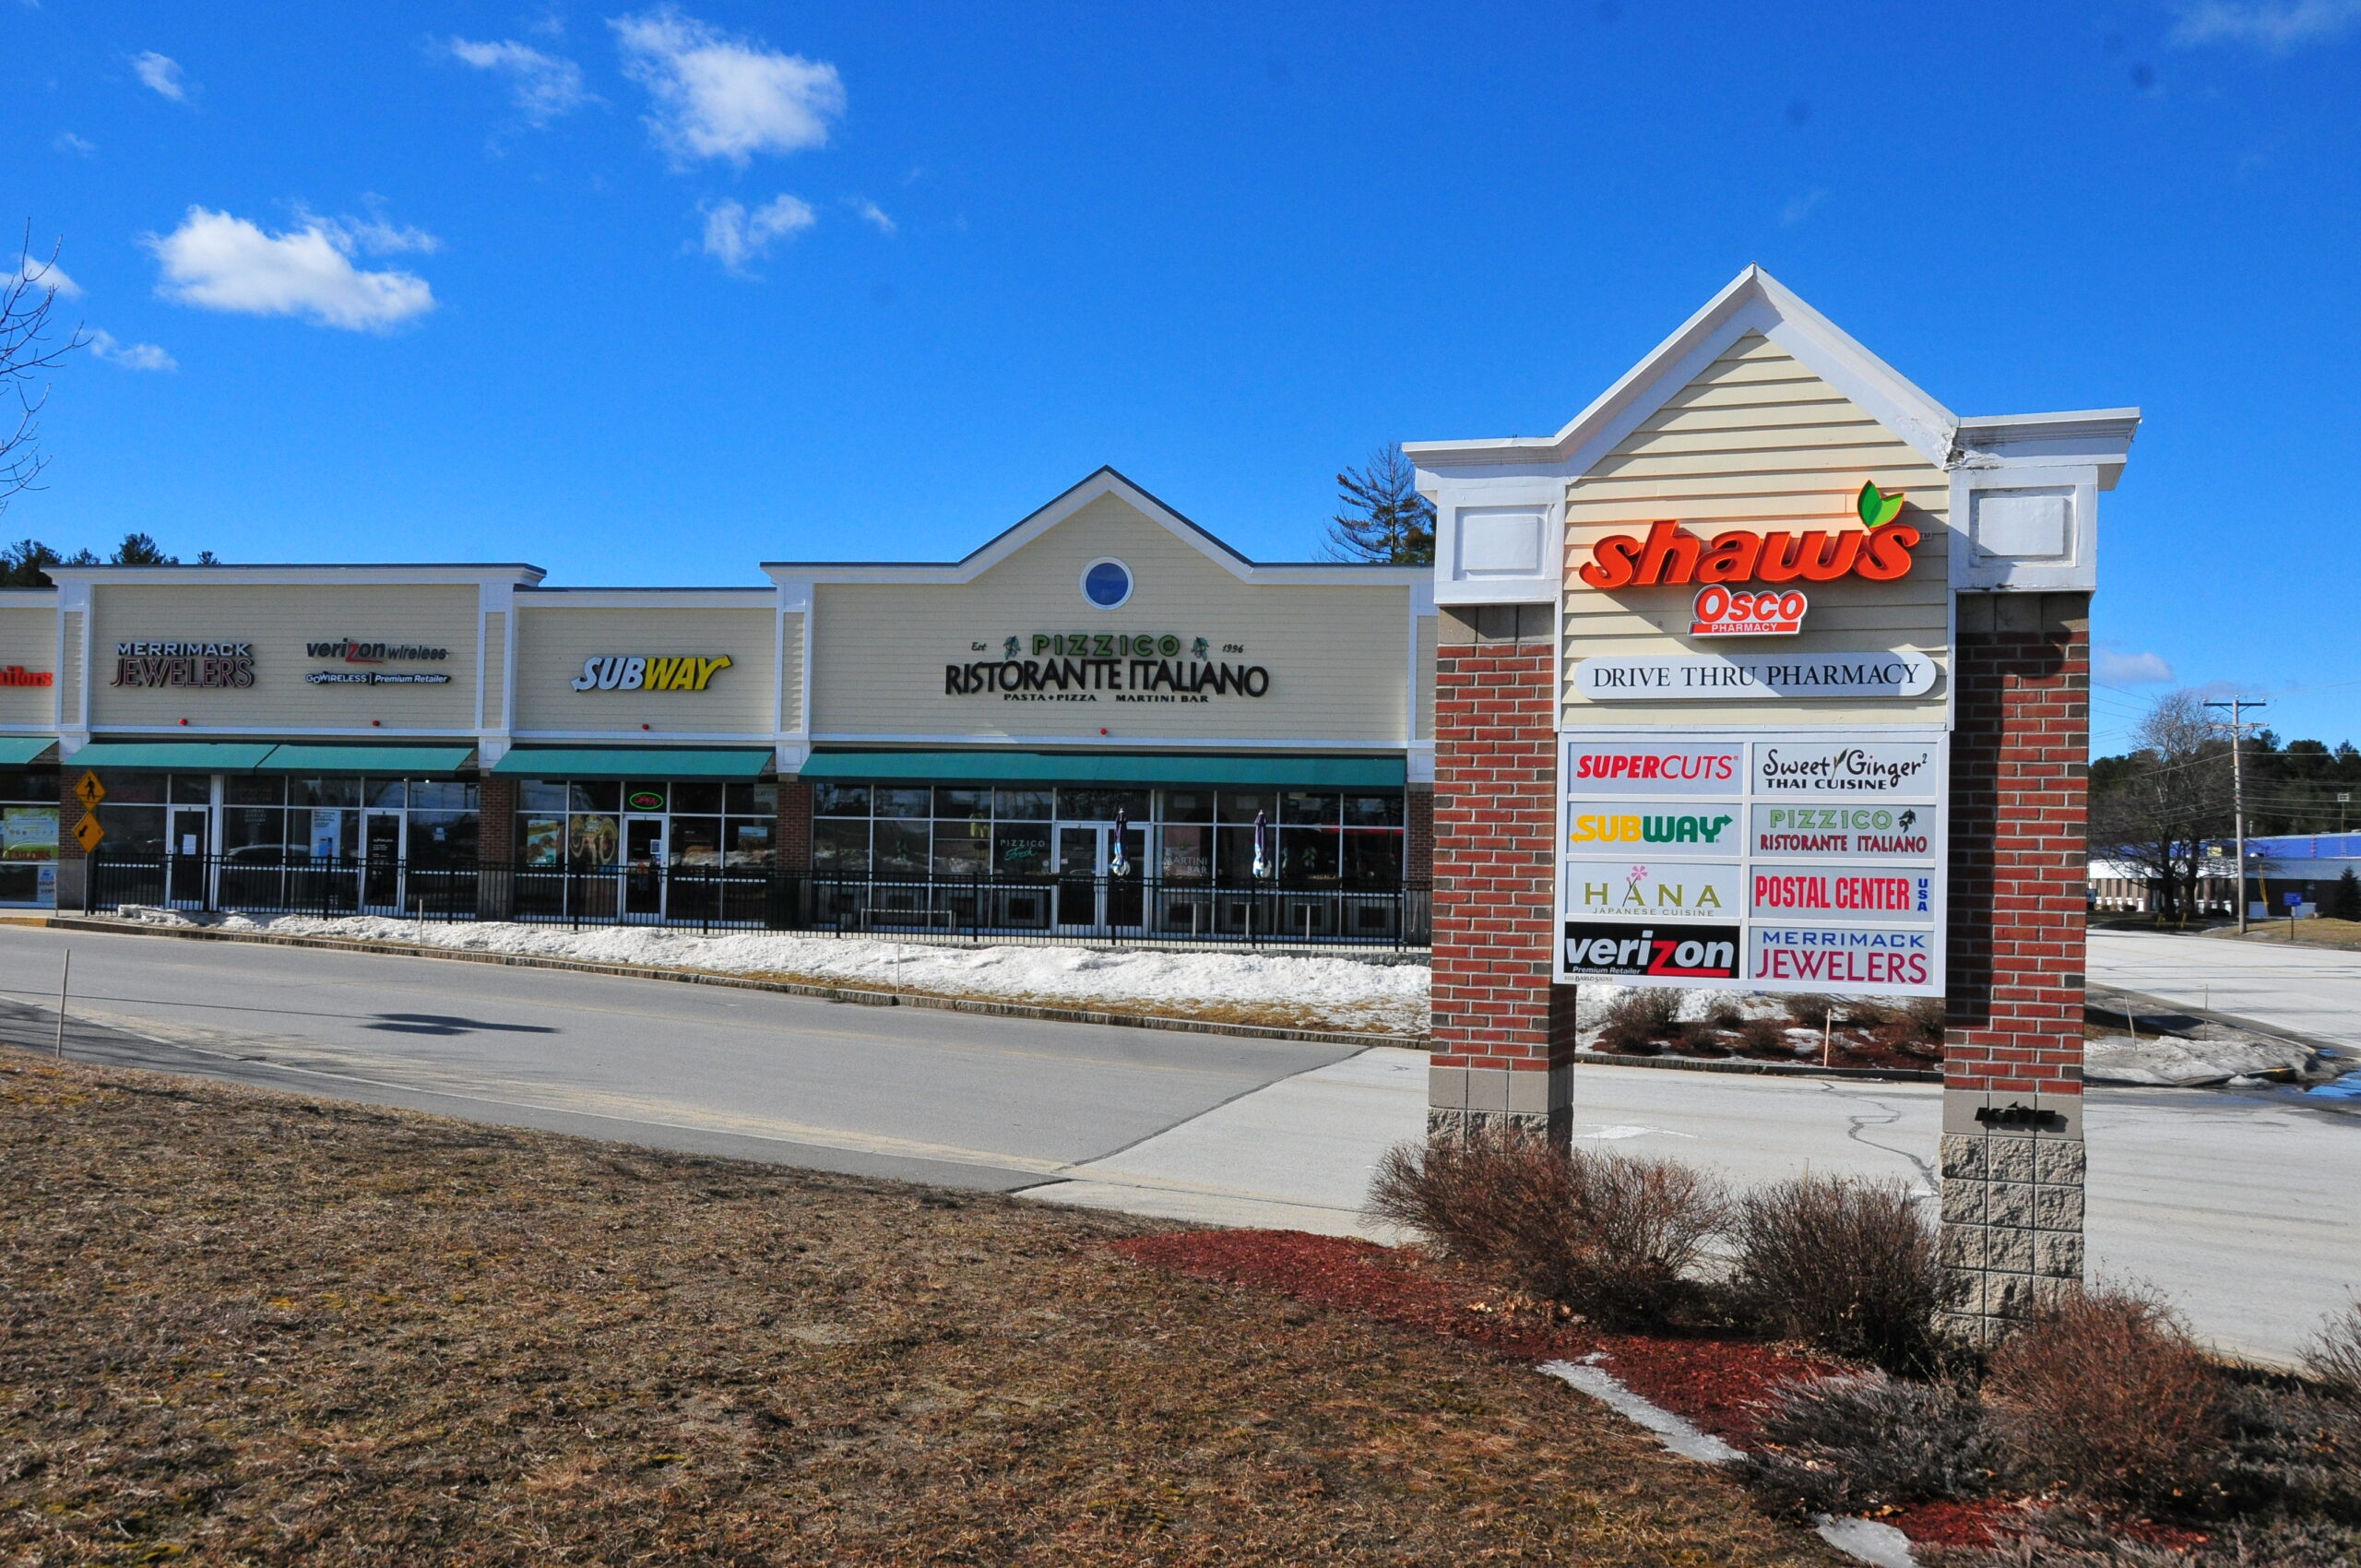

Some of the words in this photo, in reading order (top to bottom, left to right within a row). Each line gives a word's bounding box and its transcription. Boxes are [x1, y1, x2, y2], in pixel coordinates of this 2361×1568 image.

[1711, 623, 1778, 633] PHARMACY
[117, 642, 253, 658] MERRIMACK
[306, 637, 386, 663] verizon
[387, 645, 449, 660] wireless
[1032, 635, 1180, 657] PIZZICO
[1222, 643, 1244, 654] 1996
[111, 658, 255, 688] JEWELERS
[374, 674, 413, 683] Premium
[414, 674, 448, 683] Retailer
[570, 654, 733, 692] SUBWAY
[945, 659, 1121, 695] RISTORANTE
[1129, 659, 1269, 698] ITALIANO
[1593, 667, 1670, 687] DRIVE
[1680, 665, 1756, 686] THRU
[1766, 662, 1921, 686] PHARMACY
[1115, 695, 1174, 703] MARTINI
[1180, 695, 1208, 703] BAR
[1762, 748, 1831, 777] Sweet
[1765, 778, 1807, 789] THAI
[1814, 778, 1887, 790] CUISINE
[1570, 814, 1733, 843] SUBWAY
[1770, 809, 1892, 830] PIZZICO
[1000, 839, 1046, 848] PIZZICO
[1760, 834, 1847, 851] RISTORANTE
[1857, 835, 1928, 853] ITALIANO
[1163, 855, 1208, 866] MARTINI
[1187, 865, 1208, 874] BAR
[1584, 882, 1722, 908] HANA
[1755, 875, 1831, 909] POSTAL
[1835, 877, 1910, 910] CENTER
[1593, 907, 1656, 916] JAPANESE
[1662, 909, 1714, 917] CUISINE
[1762, 931, 1926, 948] MERRIMACK
[1565, 930, 1735, 977] verizon
[1572, 966, 1608, 974] Premium
[1609, 967, 1642, 975] Retailer
[1755, 948, 1927, 984] JEWELERS
